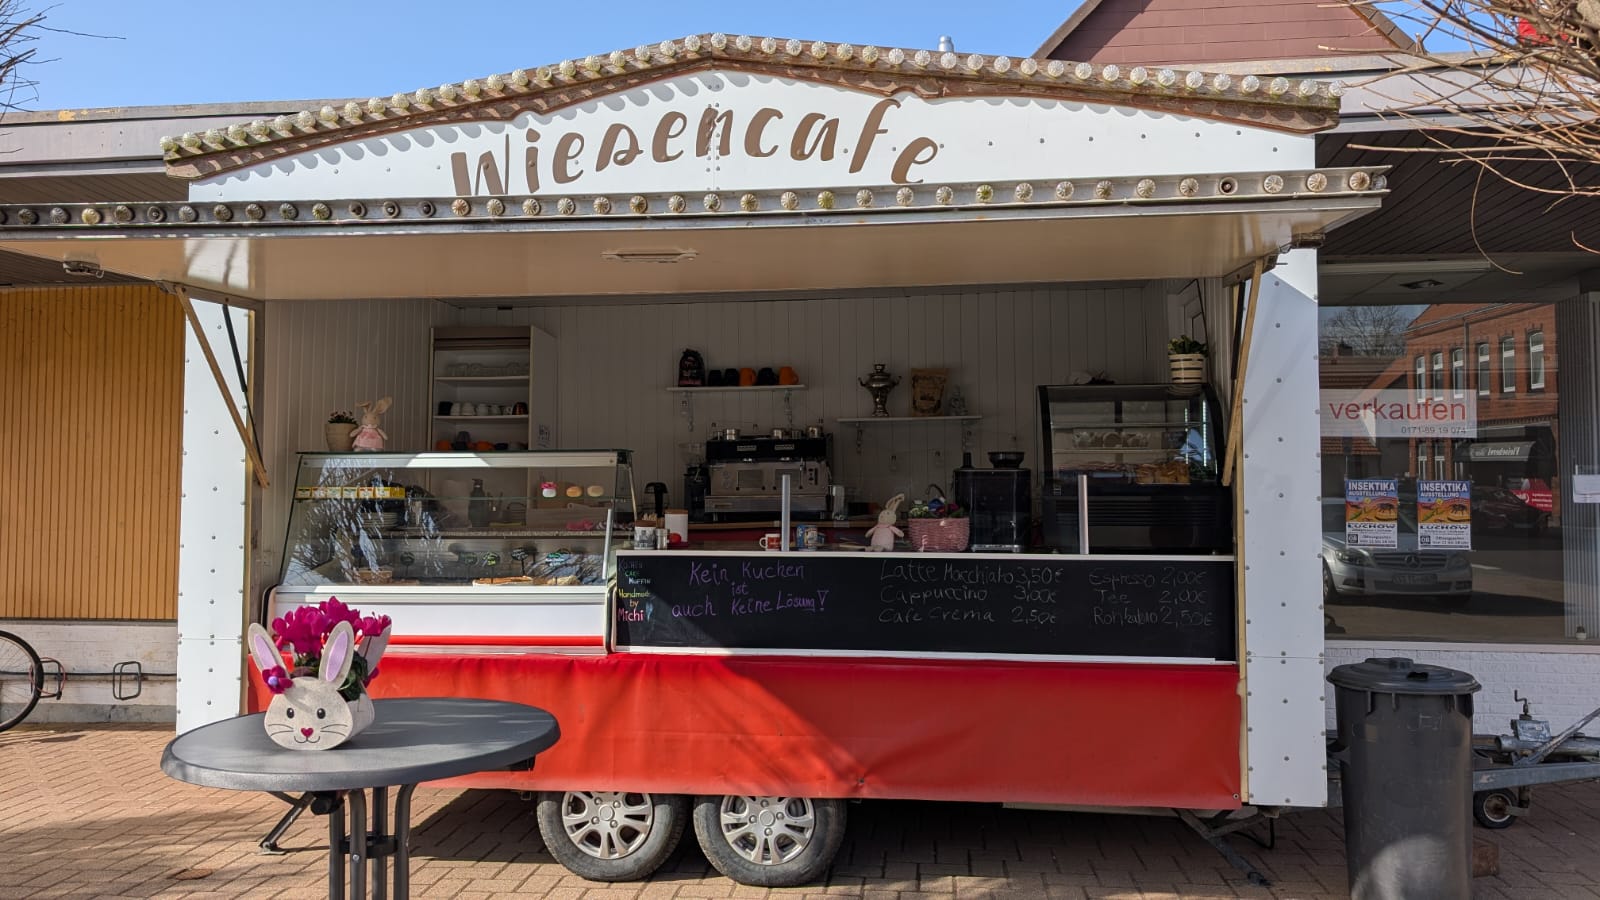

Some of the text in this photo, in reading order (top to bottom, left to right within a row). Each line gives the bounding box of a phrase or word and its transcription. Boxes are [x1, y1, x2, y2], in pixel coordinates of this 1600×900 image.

[450, 98, 939, 197] Wiesencafe
[1328, 397, 1467, 421] verkaufen
[1438, 426, 1449, 435] 19
[1348, 482, 1396, 491] INSEKTIKA
[1420, 482, 1468, 492] INSEKTIKA
[688, 561, 805, 585] Kein Kuchen
[880, 559, 936, 583] Latte
[731, 582, 750, 596] ist
[1094, 589, 1131, 604] Tee
[629, 599, 640, 609] by
[671, 595, 717, 618] auch
[617, 607, 644, 622] Michi
